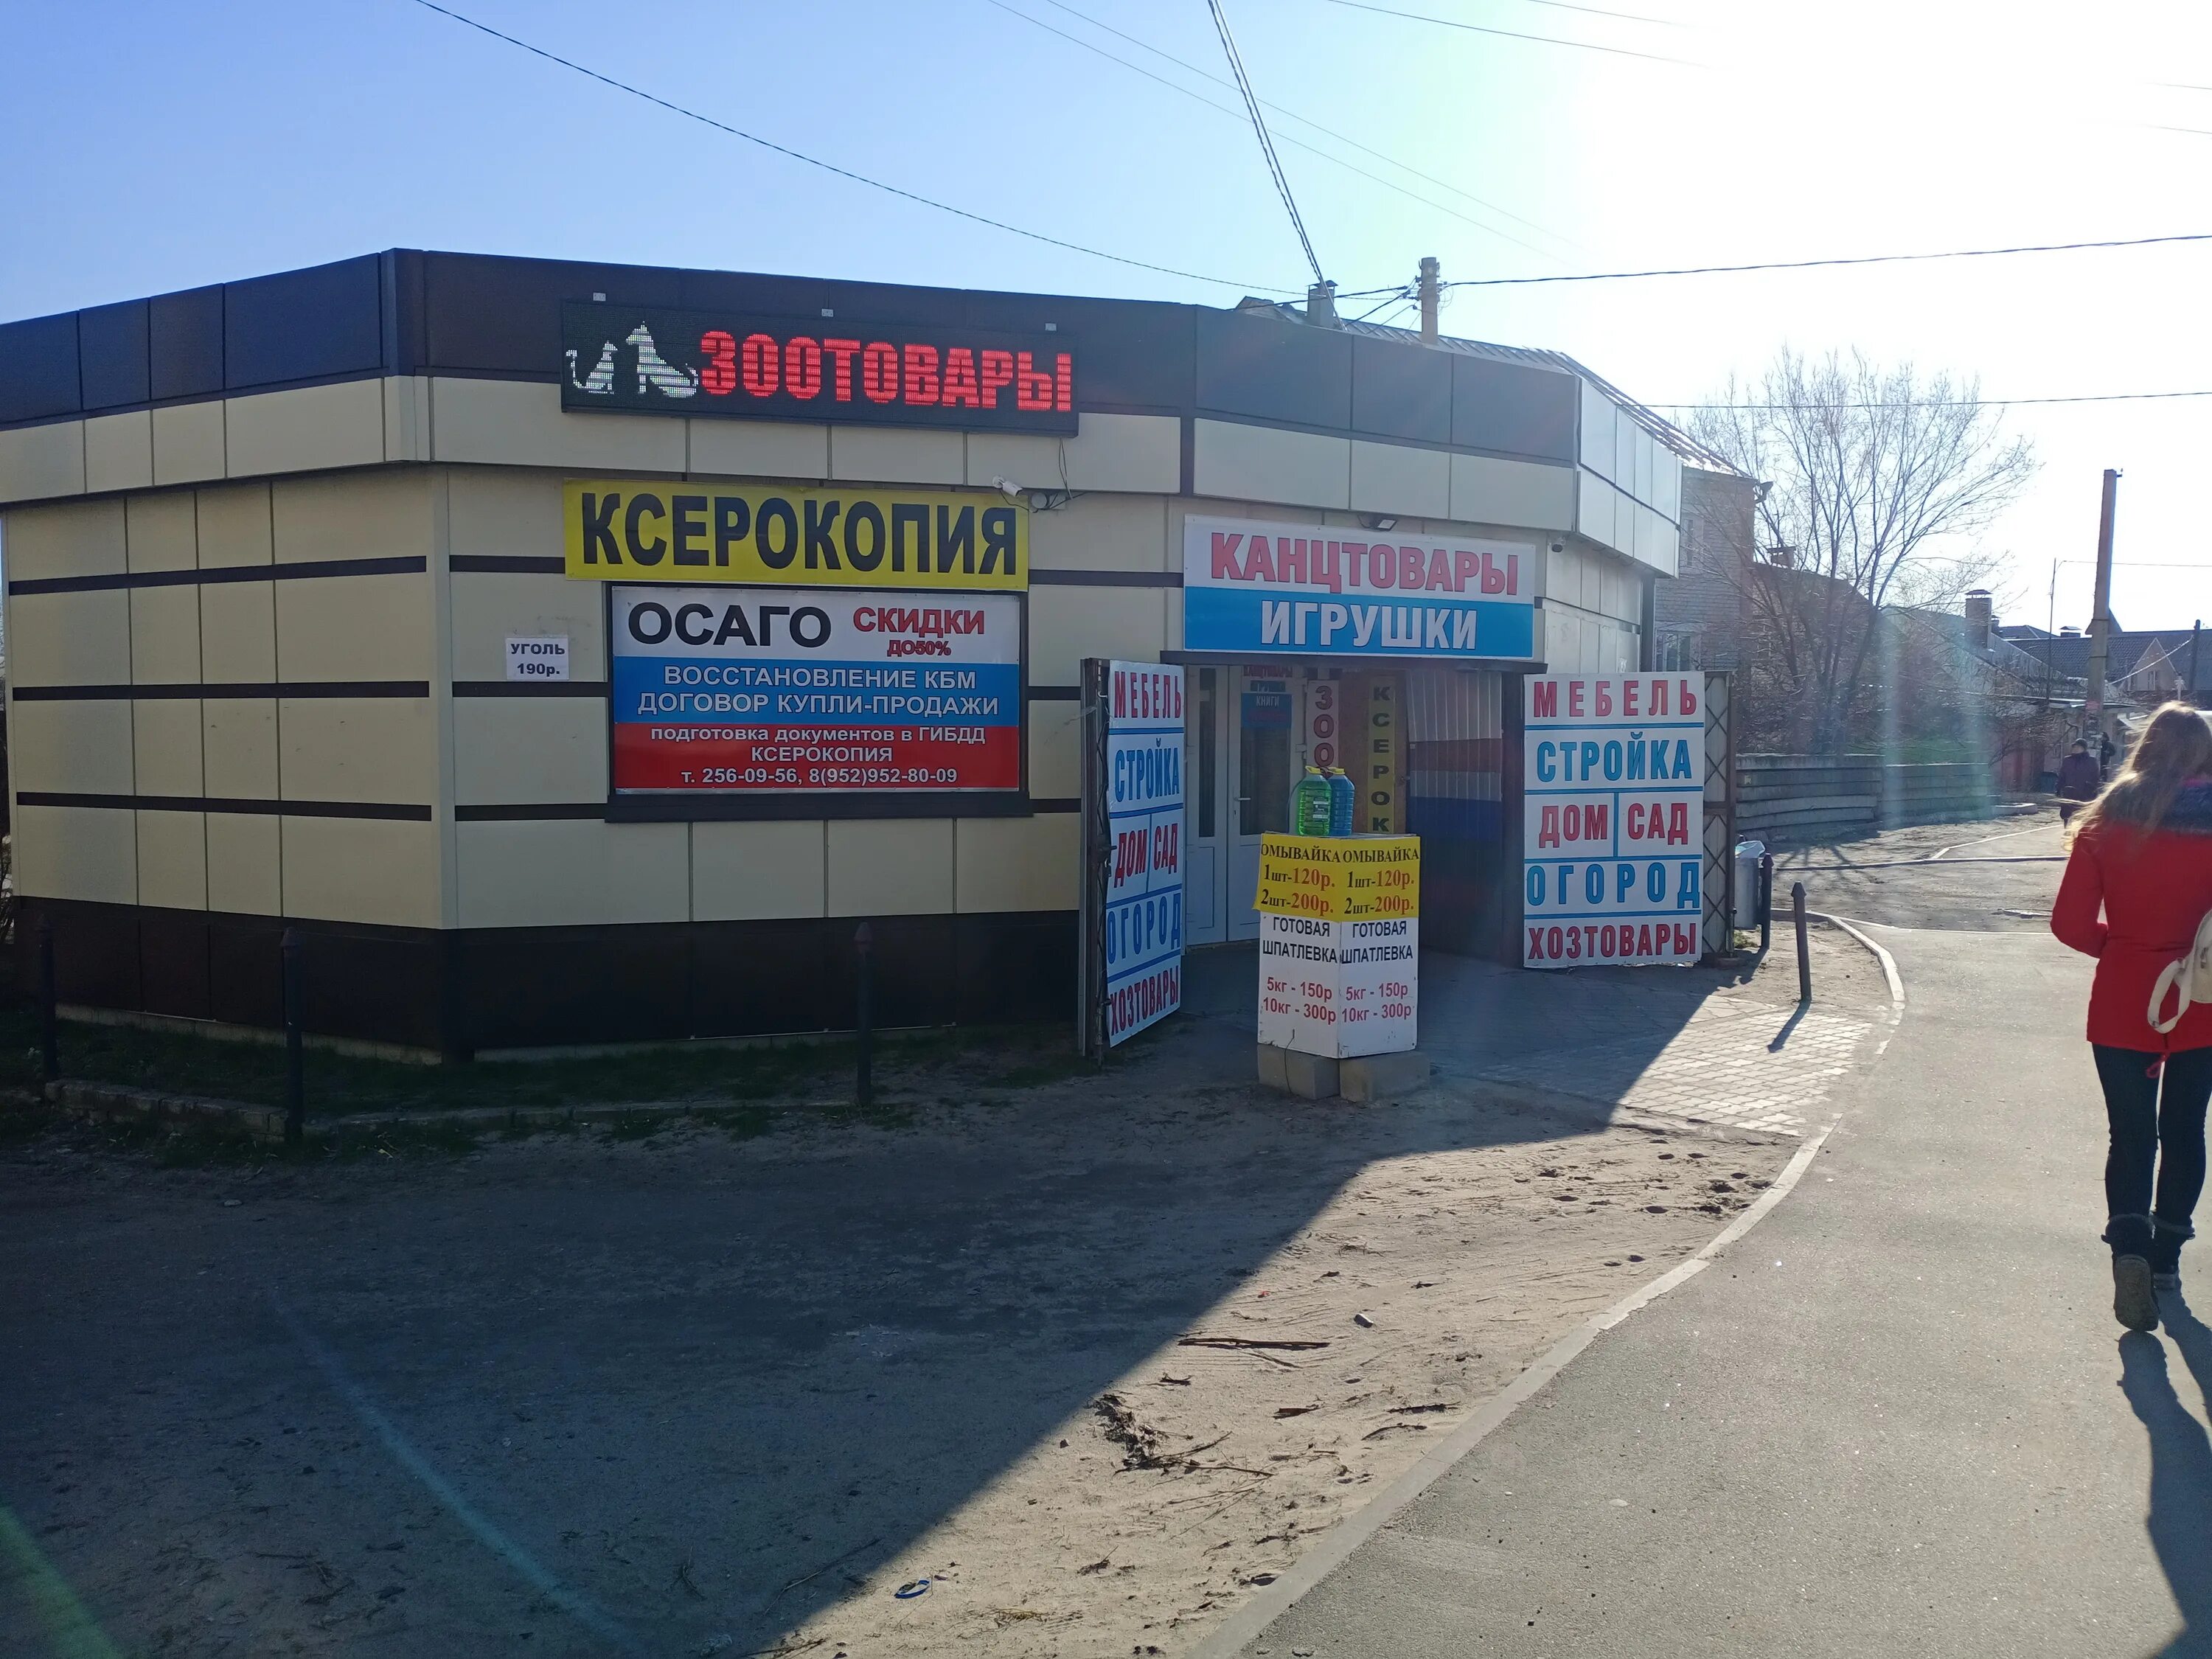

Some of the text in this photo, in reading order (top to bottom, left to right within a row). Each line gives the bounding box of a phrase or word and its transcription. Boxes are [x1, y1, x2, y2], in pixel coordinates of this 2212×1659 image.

[700, 330, 1072, 413] ЗООТОВАРЫ
[582, 493, 1017, 576] КСЕРОКОПИЯ
[1211, 532, 1519, 596] КАНЦТОВАРЫ
[627, 602, 832, 647] ОСАГО
[853, 606, 985, 639] СКИДКИ
[1261, 599, 1478, 650] ИГРУШКИ
[510, 643, 566, 655] УГОЛЬ
[517, 663, 560, 678] 190р.
[664, 665, 977, 689] ВОССТАНОВЛЕНИЕ КБМ
[637, 692, 999, 718] ДОГОВОР КУПЛИ-ПРОДАЖИ
[1114, 670, 1182, 720] МЕБЕЛЬ
[1256, 695, 1279, 707] КНИГИ
[1533, 679, 1697, 718] МЕБЕЛЬ
[651, 726, 987, 745] подготовка документов в ГИБДД
[1313, 685, 1335, 779] ЗОО
[751, 745, 893, 762] КСЕРОКОПИЯ
[1537, 731, 1693, 783] СТРОЙКА
[681, 767, 958, 787] т. 256-09-56, 8(952)952-80-09
[1114, 738, 1180, 803] СТРОЙКА
[1539, 802, 1688, 849] ДОМ САД
[1113, 822, 1179, 888] ДОМ САД
[1261, 843, 1340, 863] ОМЫВАЙКА
[1343, 846, 1419, 863] ОМЫВАЙКА
[1264, 863, 1335, 891] 1шт-120р.
[1346, 869, 1414, 890] 1шт-120р.
[1526, 861, 1700, 909] ОГОРОД
[1261, 888, 1334, 916] 2шт-200р.
[1344, 896, 1414, 915] 2шт-200р.
[1107, 892, 1181, 965] ОГОРОД
[1273, 917, 1330, 937] ГОТОВАЯ
[1352, 920, 1407, 938] ГОТОВАЯ
[1528, 922, 1696, 959] ХОЗТОВАРЫ
[1262, 939, 1338, 964] ШПАТЛЕВКА
[1341, 945, 1413, 964] ШПАТЛЕВКА
[1110, 964, 1180, 1037] ХОЗТОВАРЫ
[1267, 976, 1287, 993] 5кг
[1300, 981, 1333, 1003] 150р
[1346, 986, 1366, 1001] 5кг
[1378, 981, 1408, 999] 150р
[1263, 997, 1292, 1015] 10кг
[1303, 1003, 1337, 1025] 300р
[1341, 1007, 1369, 1023] 10кг
[1381, 1003, 1412, 1020] 300р
